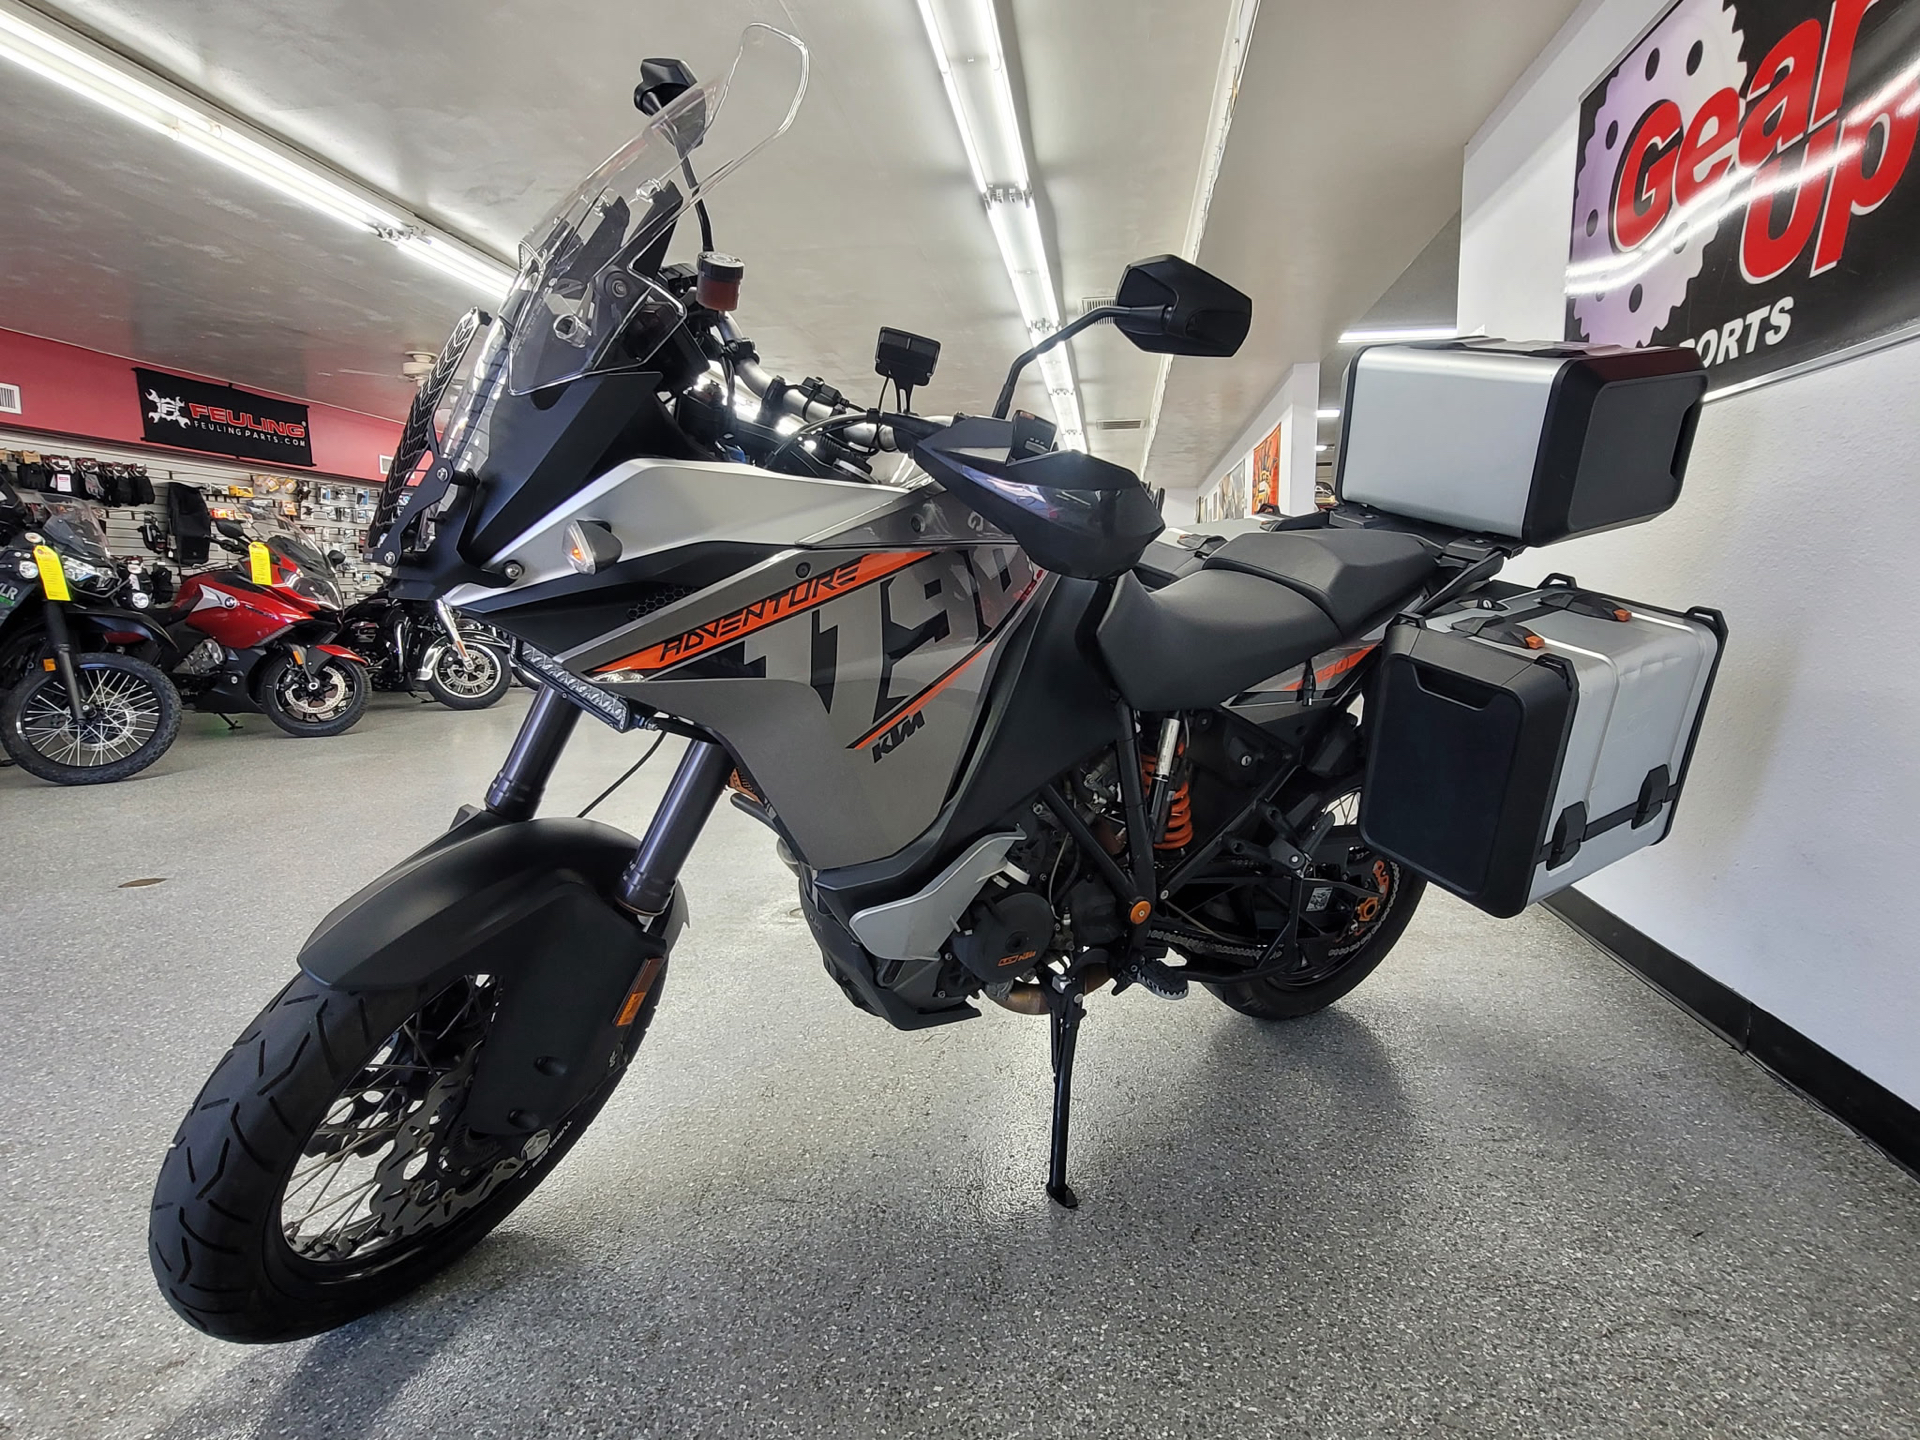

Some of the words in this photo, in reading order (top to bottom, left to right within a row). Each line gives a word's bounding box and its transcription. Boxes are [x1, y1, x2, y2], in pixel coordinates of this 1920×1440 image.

[1613, 0, 1879, 254] Gear
[1739, 79, 1919, 284] Up
[1679, 296, 1794, 368] ORTS
[189, 402, 306, 438] FEULING
[0, 583, 19, 600] LR
[659, 561, 862, 662] ADVENTURE
[872, 710, 925, 763] KTM
